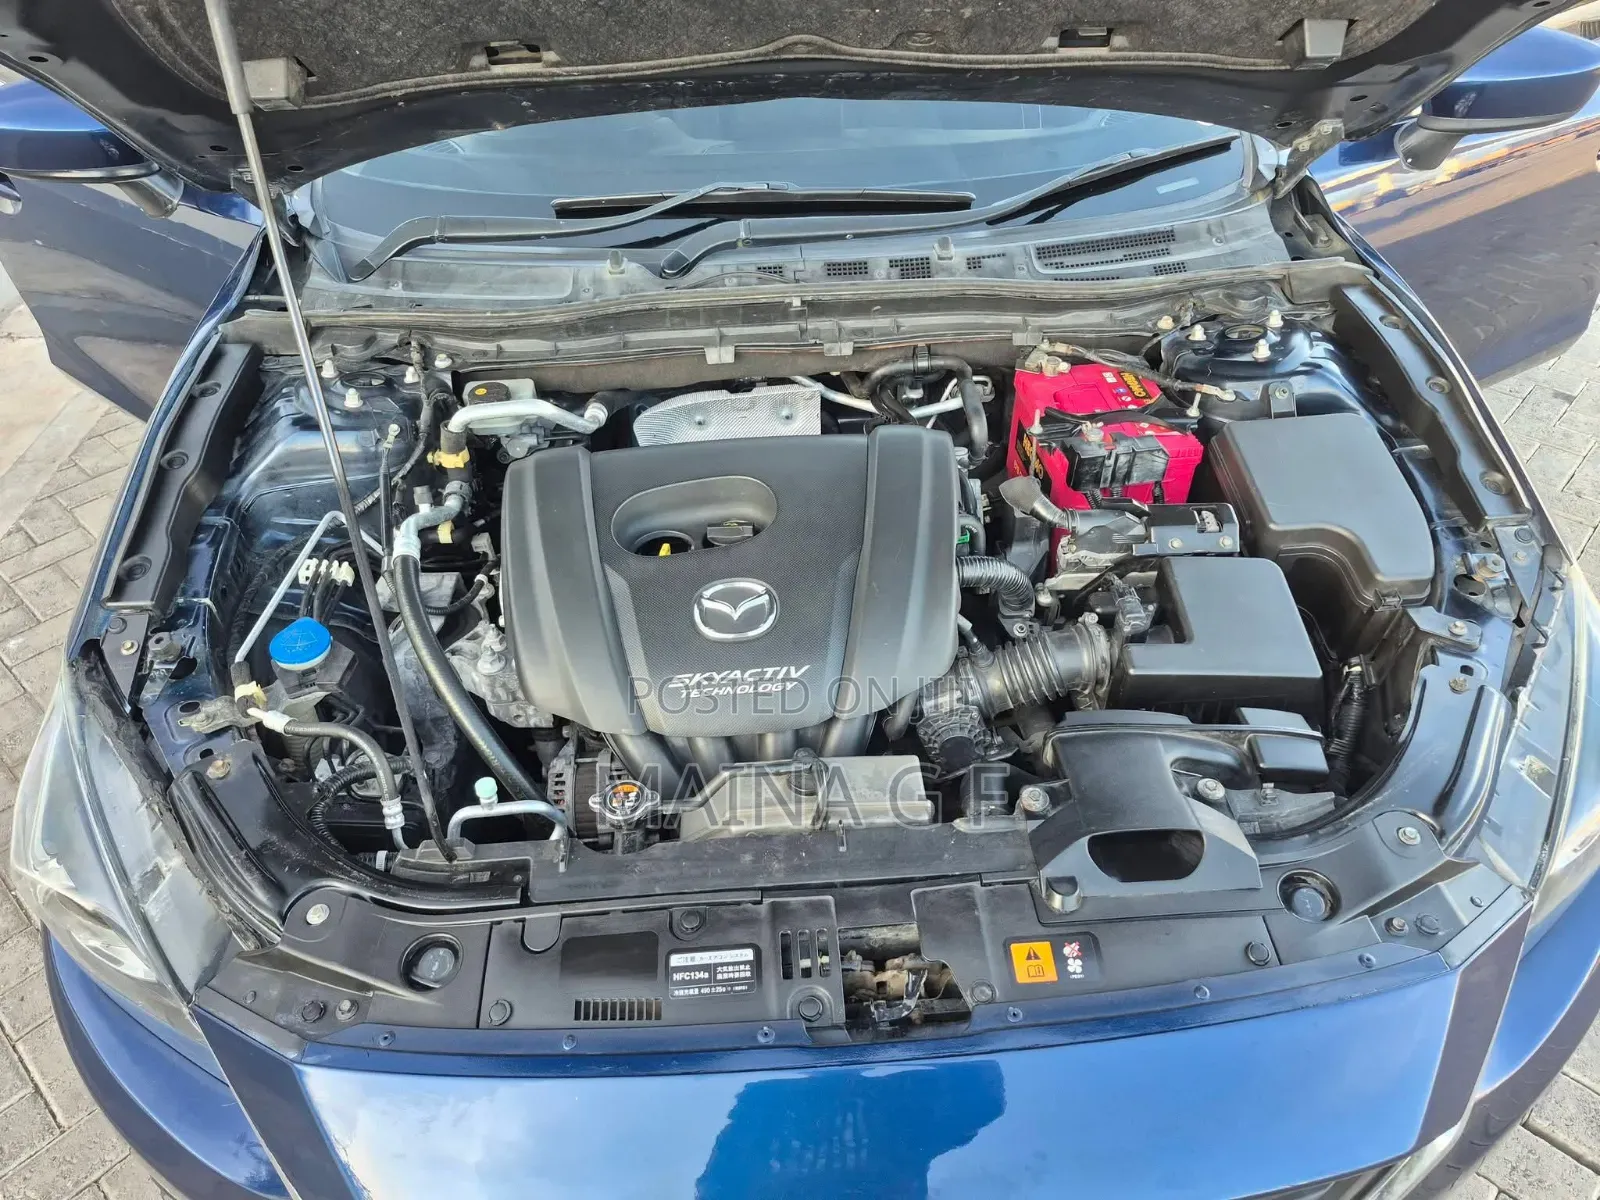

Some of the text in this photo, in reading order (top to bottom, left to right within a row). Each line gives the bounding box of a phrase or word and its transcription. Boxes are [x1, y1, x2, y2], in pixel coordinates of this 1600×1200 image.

[668, 664, 811, 688] SKYACTIV
[680, 681, 799, 699] TECHNOLOGY
[672, 970, 710, 982] HFC134a
